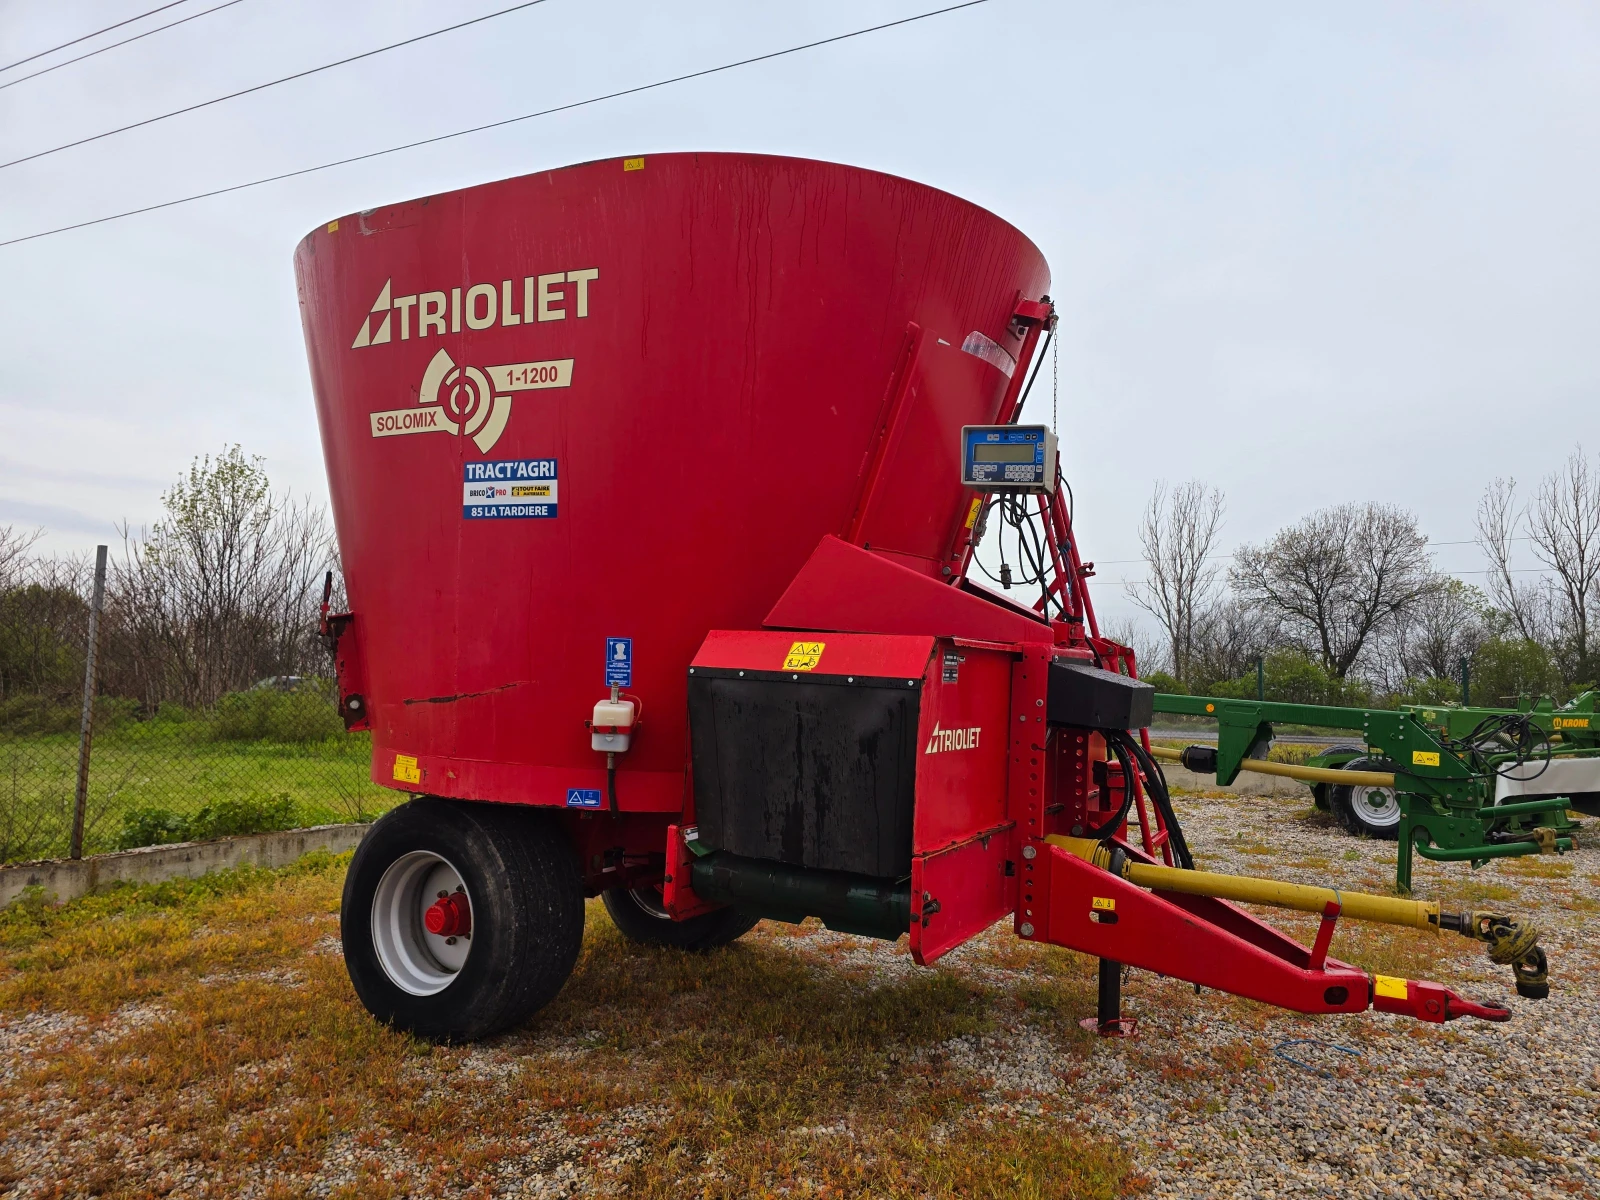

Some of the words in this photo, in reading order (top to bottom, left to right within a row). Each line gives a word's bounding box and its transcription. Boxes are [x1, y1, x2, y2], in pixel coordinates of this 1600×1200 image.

[393, 267, 599, 340] TRIOLIET
[506, 366, 558, 386] 1-1200
[376, 411, 437, 432] SOLOMIX
[466, 461, 555, 479] TRACT'AGRI
[469, 489, 486, 497] BRICO
[495, 488, 507, 496] PRO
[471, 507, 483, 517] 85
[484, 506, 497, 517] LA
[498, 505, 548, 516] TARDIERE
[1562, 718, 1589, 728] KRONE
[938, 727, 982, 753] TRIOLIET
